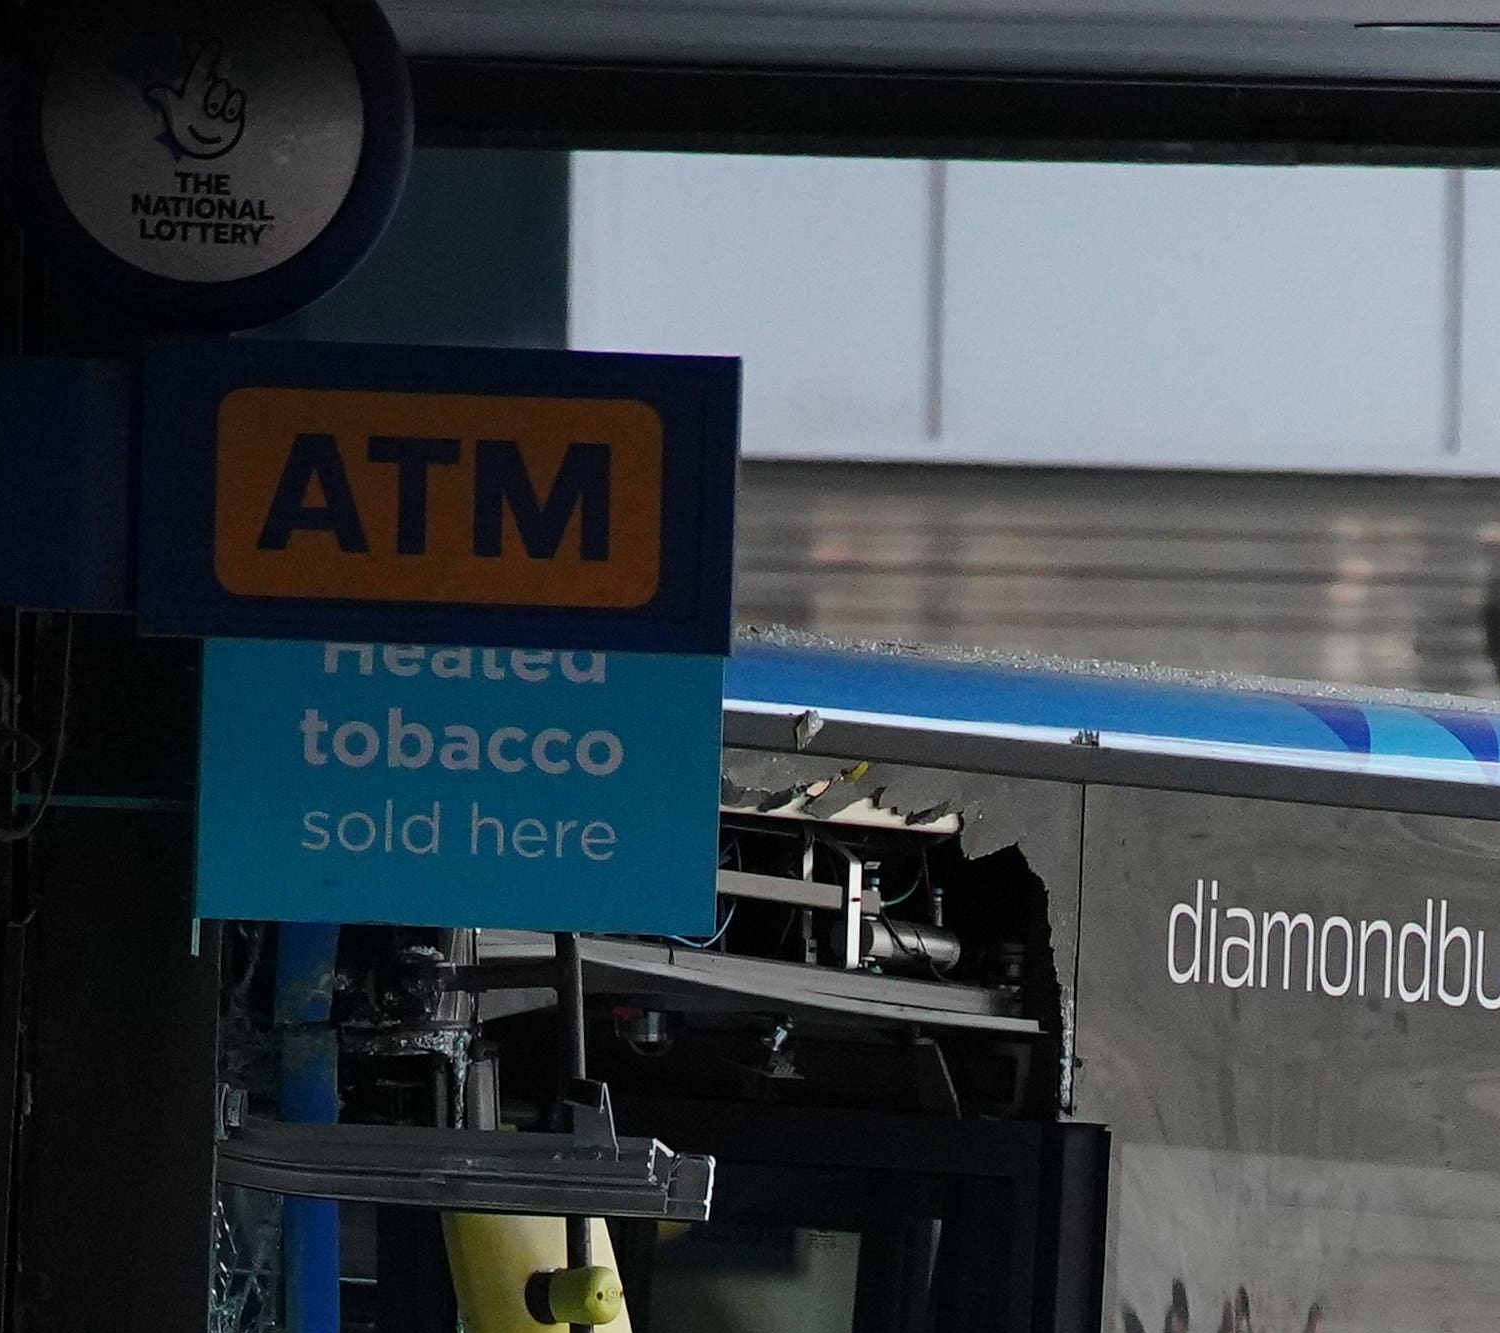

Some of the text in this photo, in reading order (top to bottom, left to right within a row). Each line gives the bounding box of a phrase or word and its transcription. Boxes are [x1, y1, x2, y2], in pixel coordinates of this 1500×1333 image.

[174, 171, 231, 196] THE
[131, 193, 275, 221] NATIONAL
[140, 218, 266, 246] LOTTERY
[255, 433, 613, 562] ATM
[299, 706, 626, 777] tobacco
[300, 799, 619, 862] sold here
